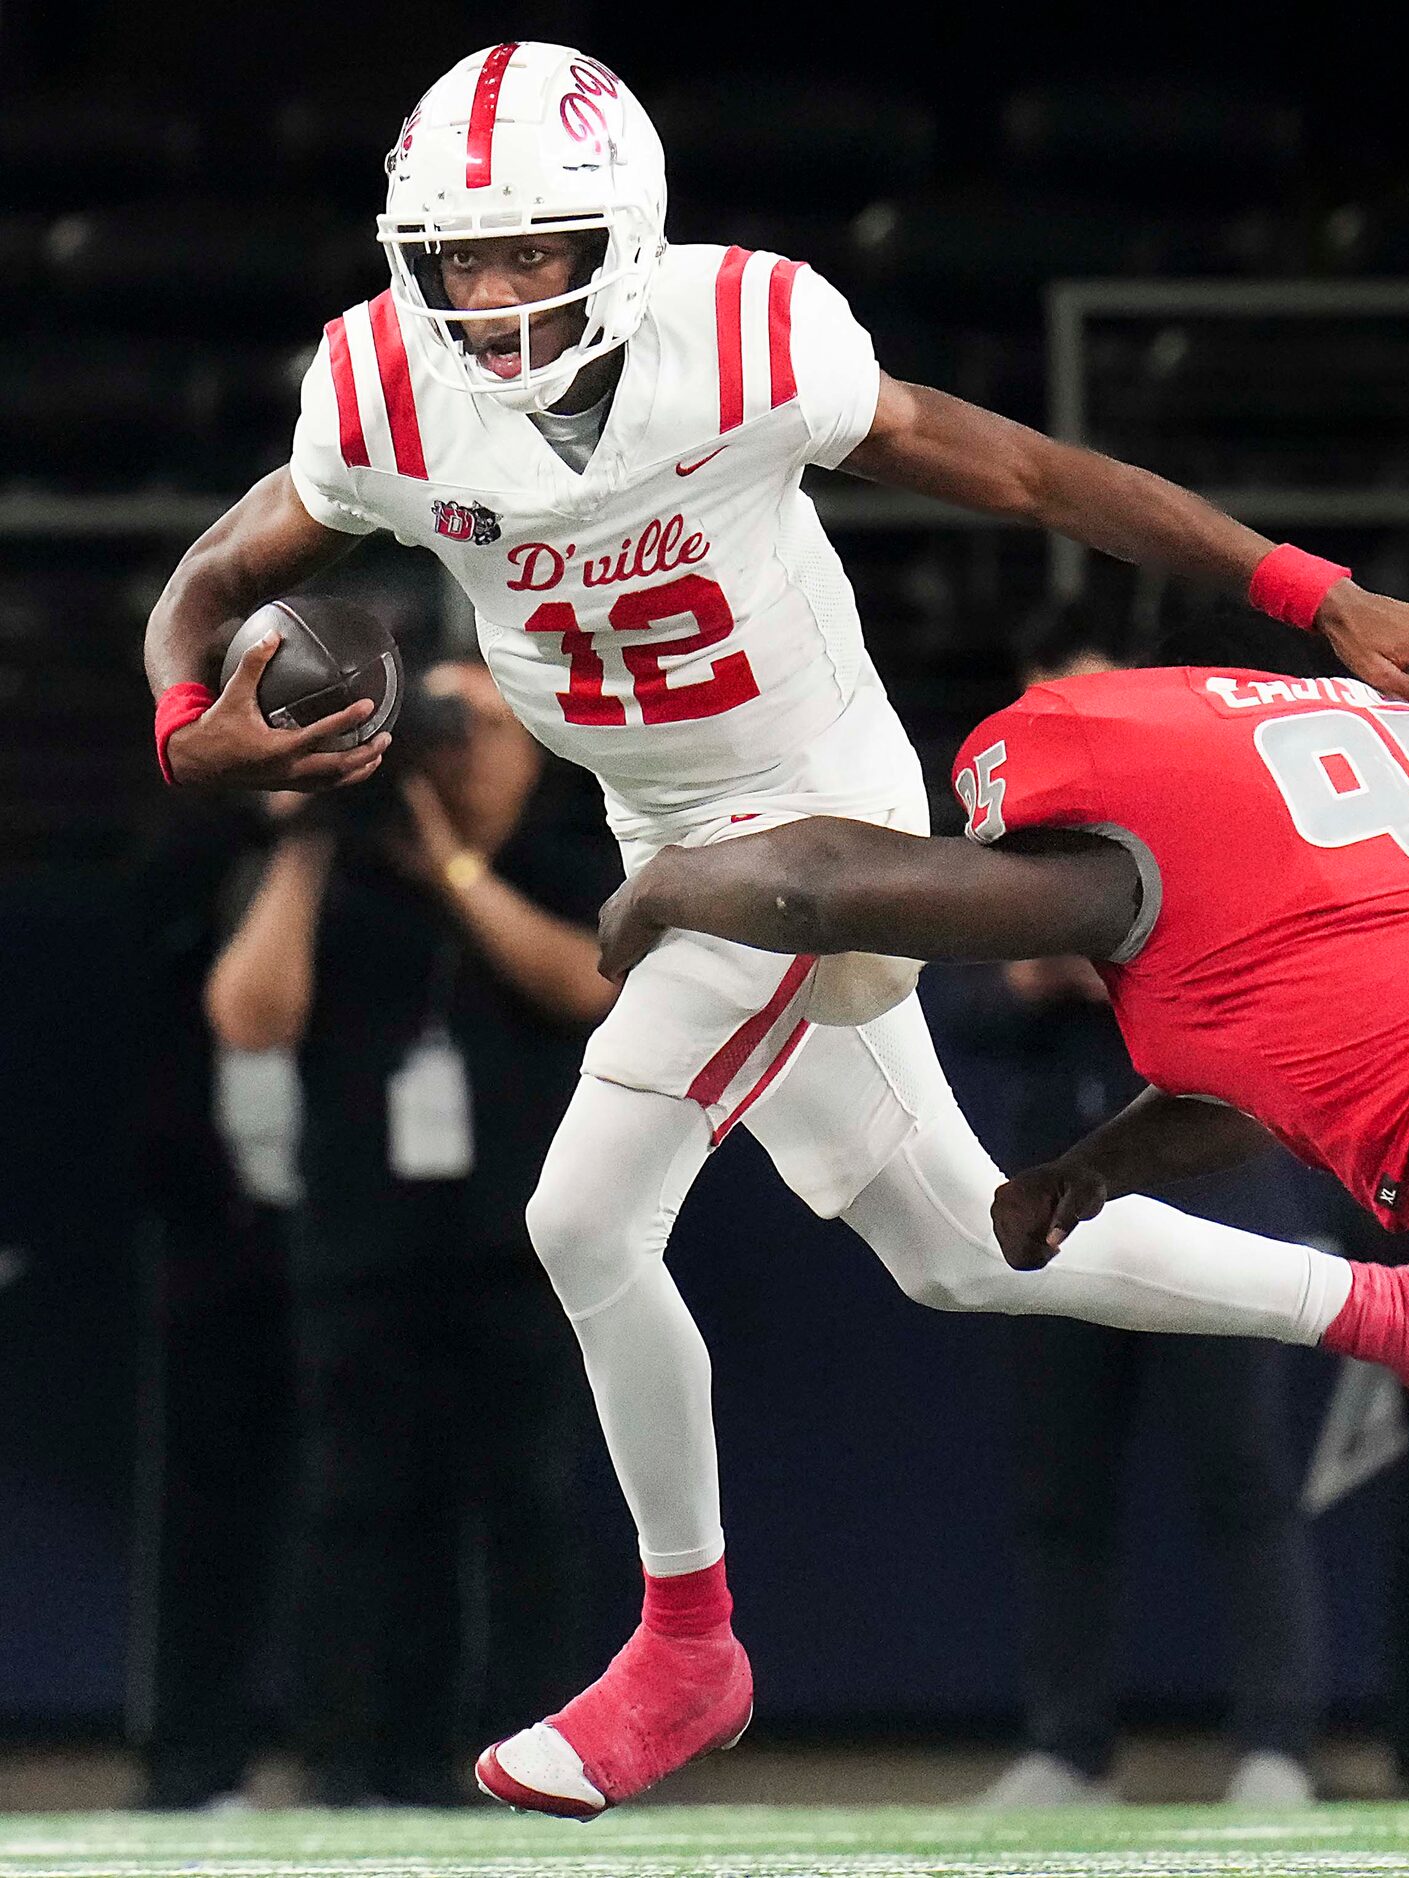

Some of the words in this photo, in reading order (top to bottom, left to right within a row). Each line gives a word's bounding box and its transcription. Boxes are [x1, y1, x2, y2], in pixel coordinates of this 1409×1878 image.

[506, 514, 711, 592] D'ville
[524, 574, 761, 727] 12
[955, 740, 1008, 843] 95
[1380, 1187, 1397, 1206] XL
